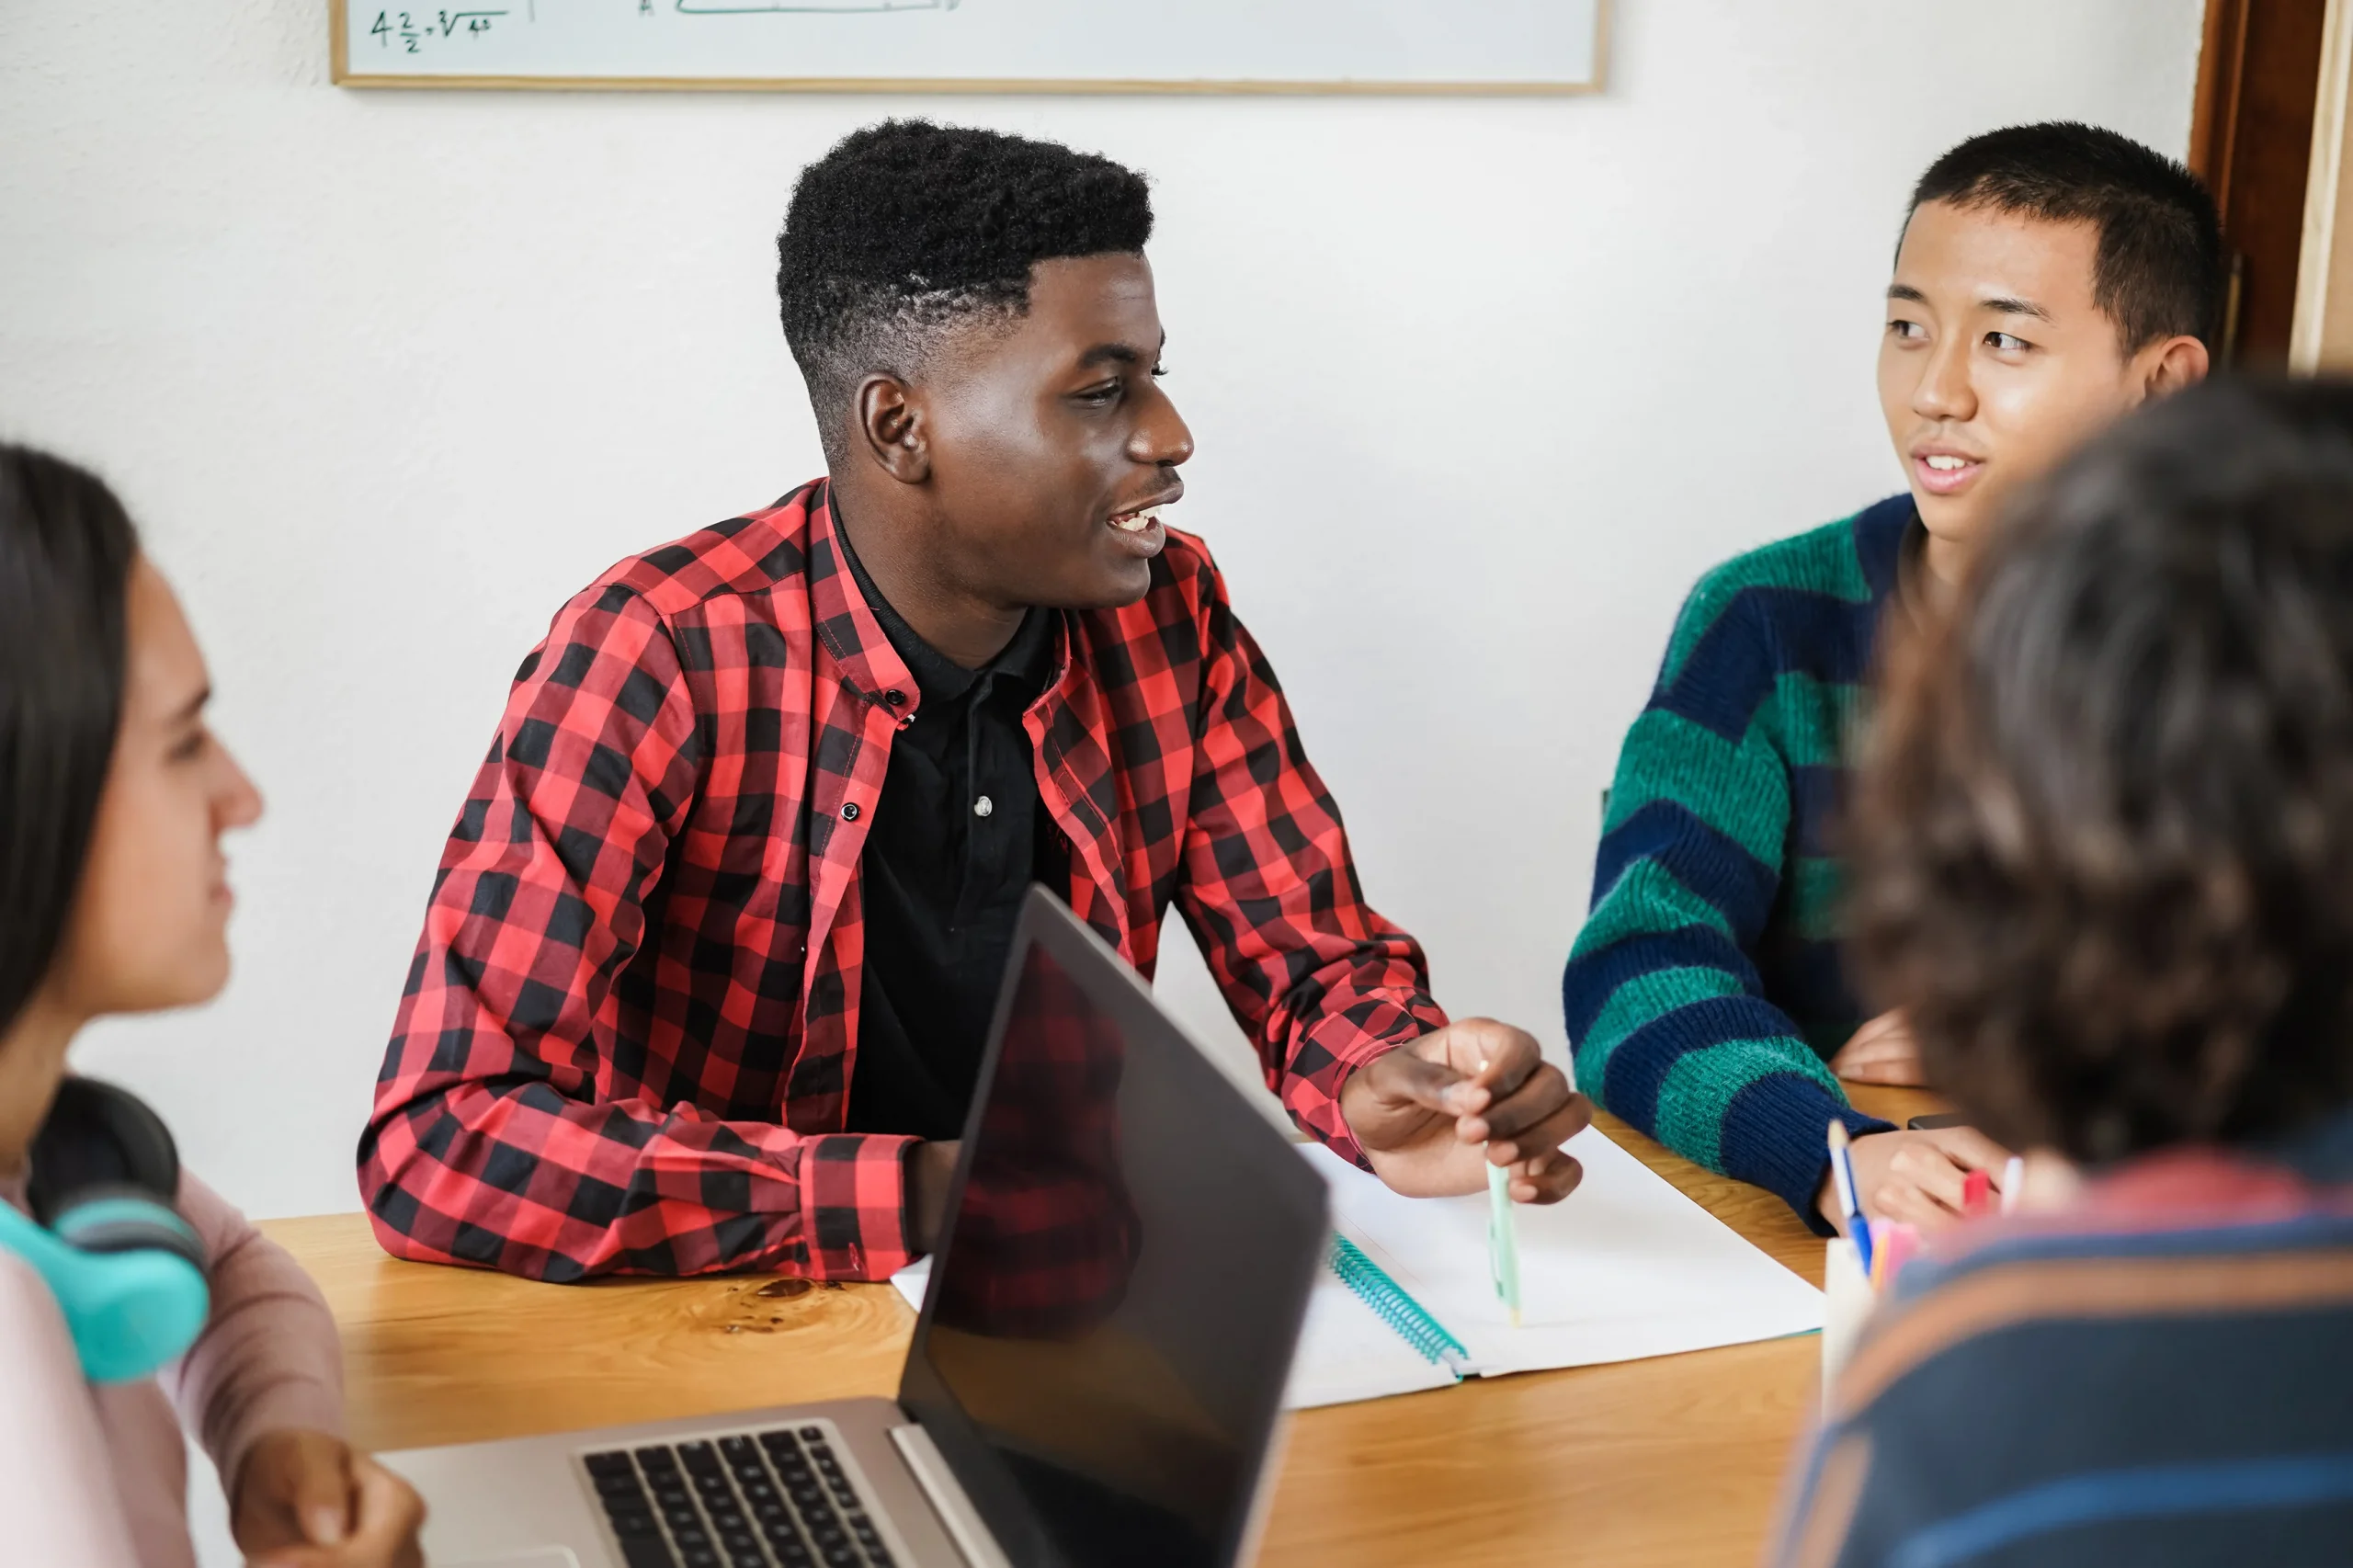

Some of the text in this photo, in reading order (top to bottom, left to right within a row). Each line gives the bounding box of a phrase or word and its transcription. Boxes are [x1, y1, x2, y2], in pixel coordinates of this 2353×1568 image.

[370, 10, 393, 48] 4
[399, 12, 414, 28] 2
[405, 40, 421, 53] 2
